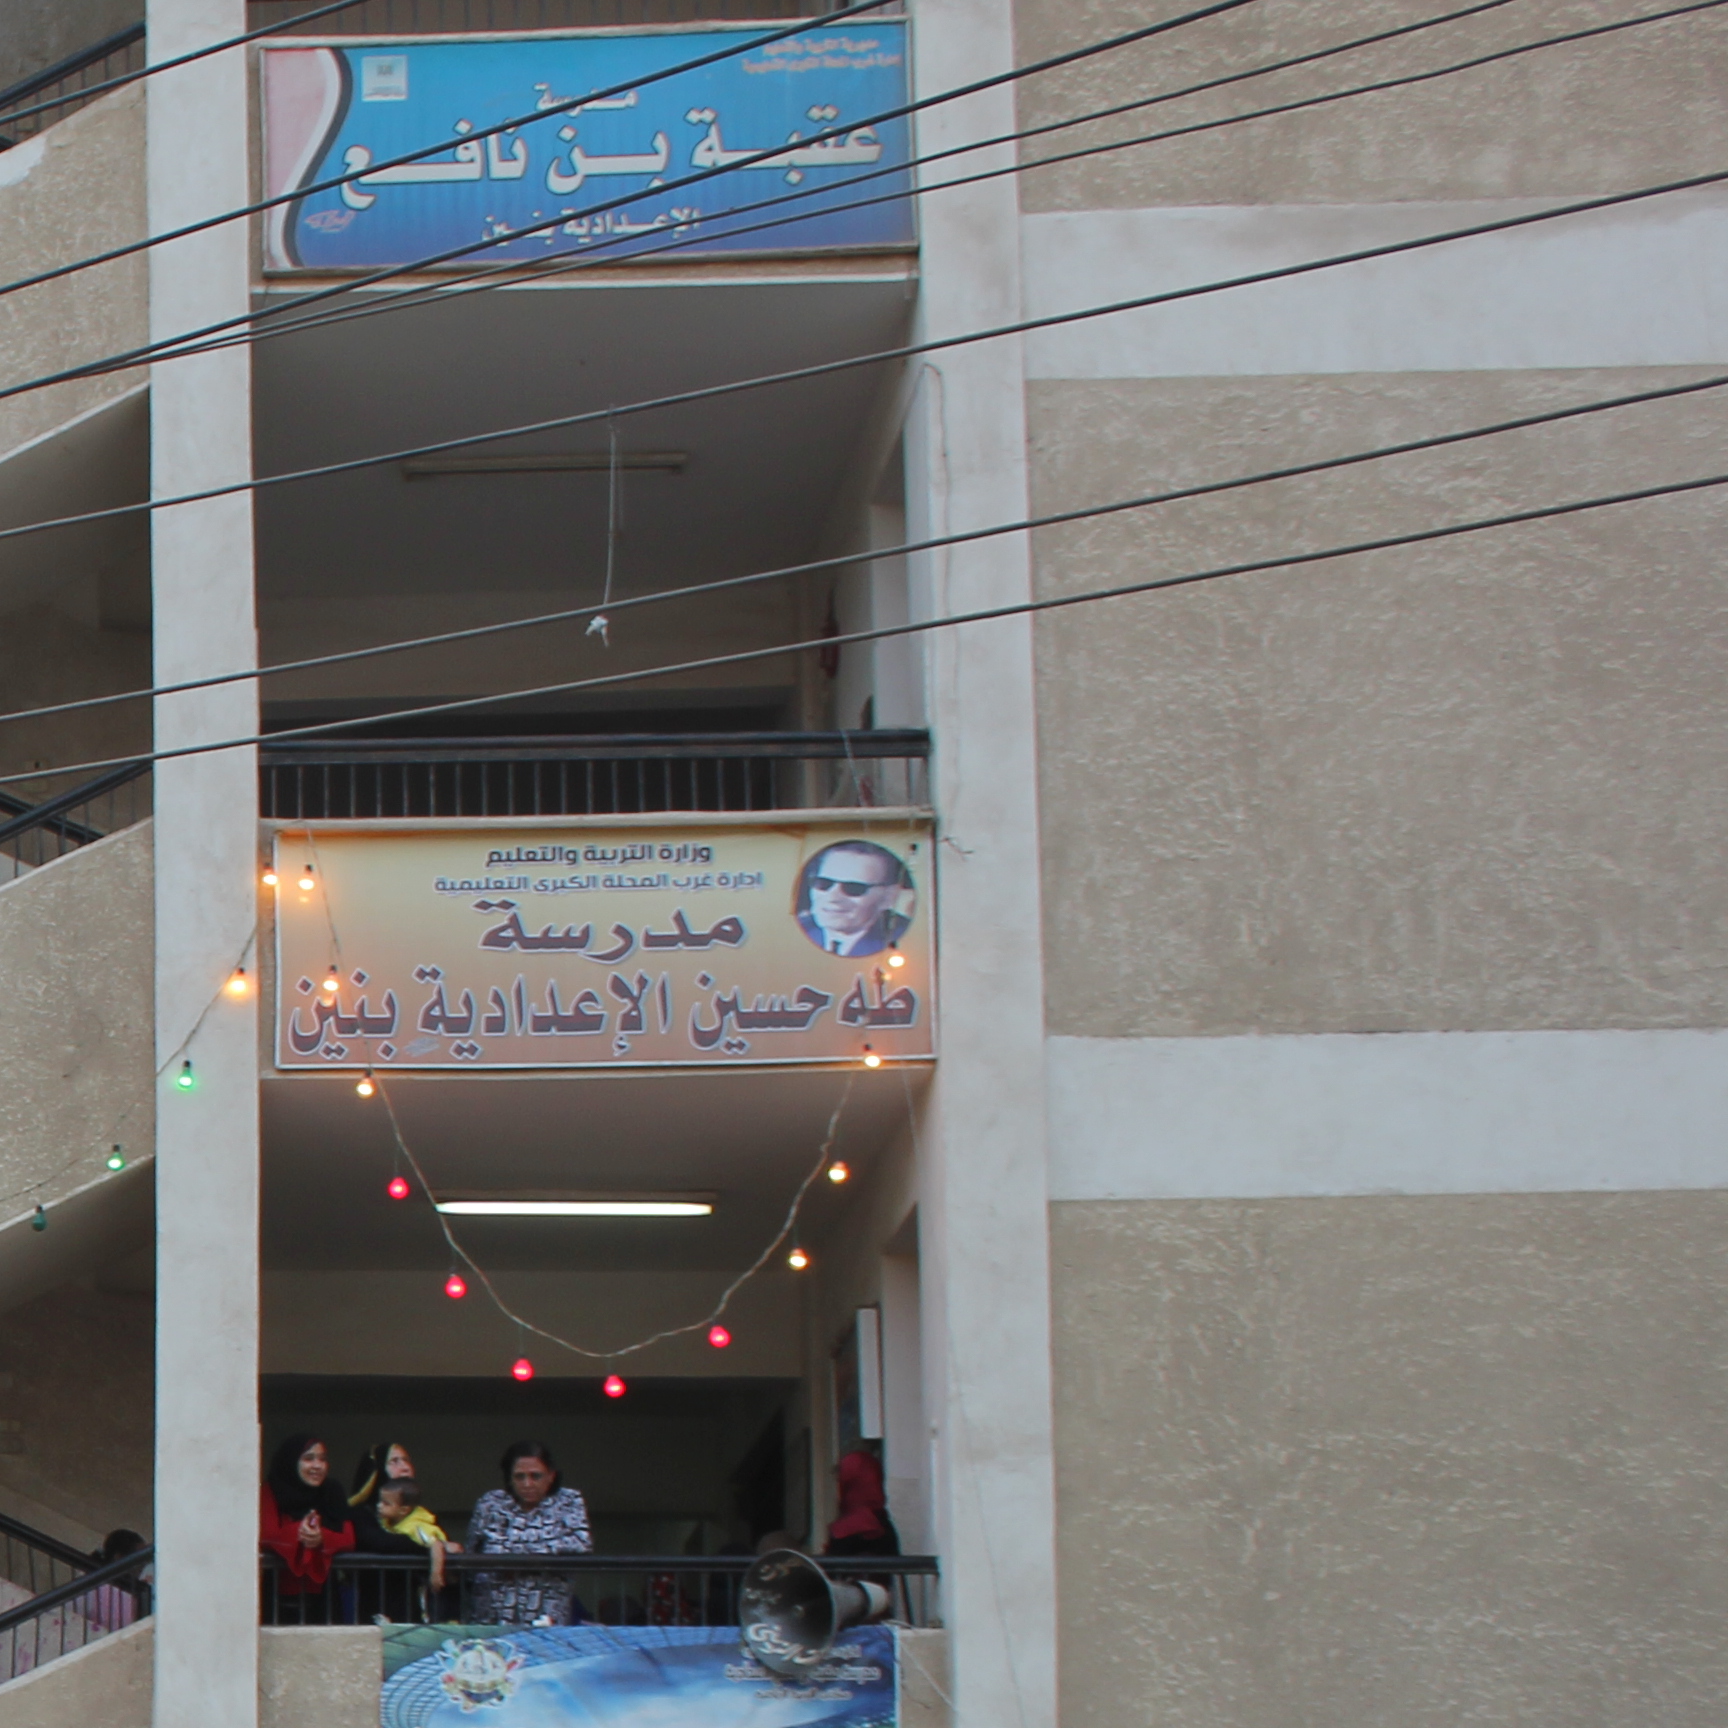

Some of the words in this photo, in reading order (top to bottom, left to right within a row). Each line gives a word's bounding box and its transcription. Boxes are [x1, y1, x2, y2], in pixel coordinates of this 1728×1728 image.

[340, 117, 528, 210] نافع
[546, 124, 672, 195] بن
[682, 105, 882, 186] عقبة
[433, 875, 527, 894] التعليمية
[485, 845, 578, 868] والتعليم
[532, 874, 595, 894] الكبرى
[583, 844, 652, 865] التربية
[602, 872, 667, 890] المحلة
[658, 844, 712, 865] وزارة
[672, 874, 713, 891] غرب
[470, 898, 748, 964] مدرسة
[288, 966, 400, 1060] بنين
[412, 963, 673, 1059] الإعدادية
[688, 968, 832, 1056] حسين
[835, 964, 919, 1030] طه
